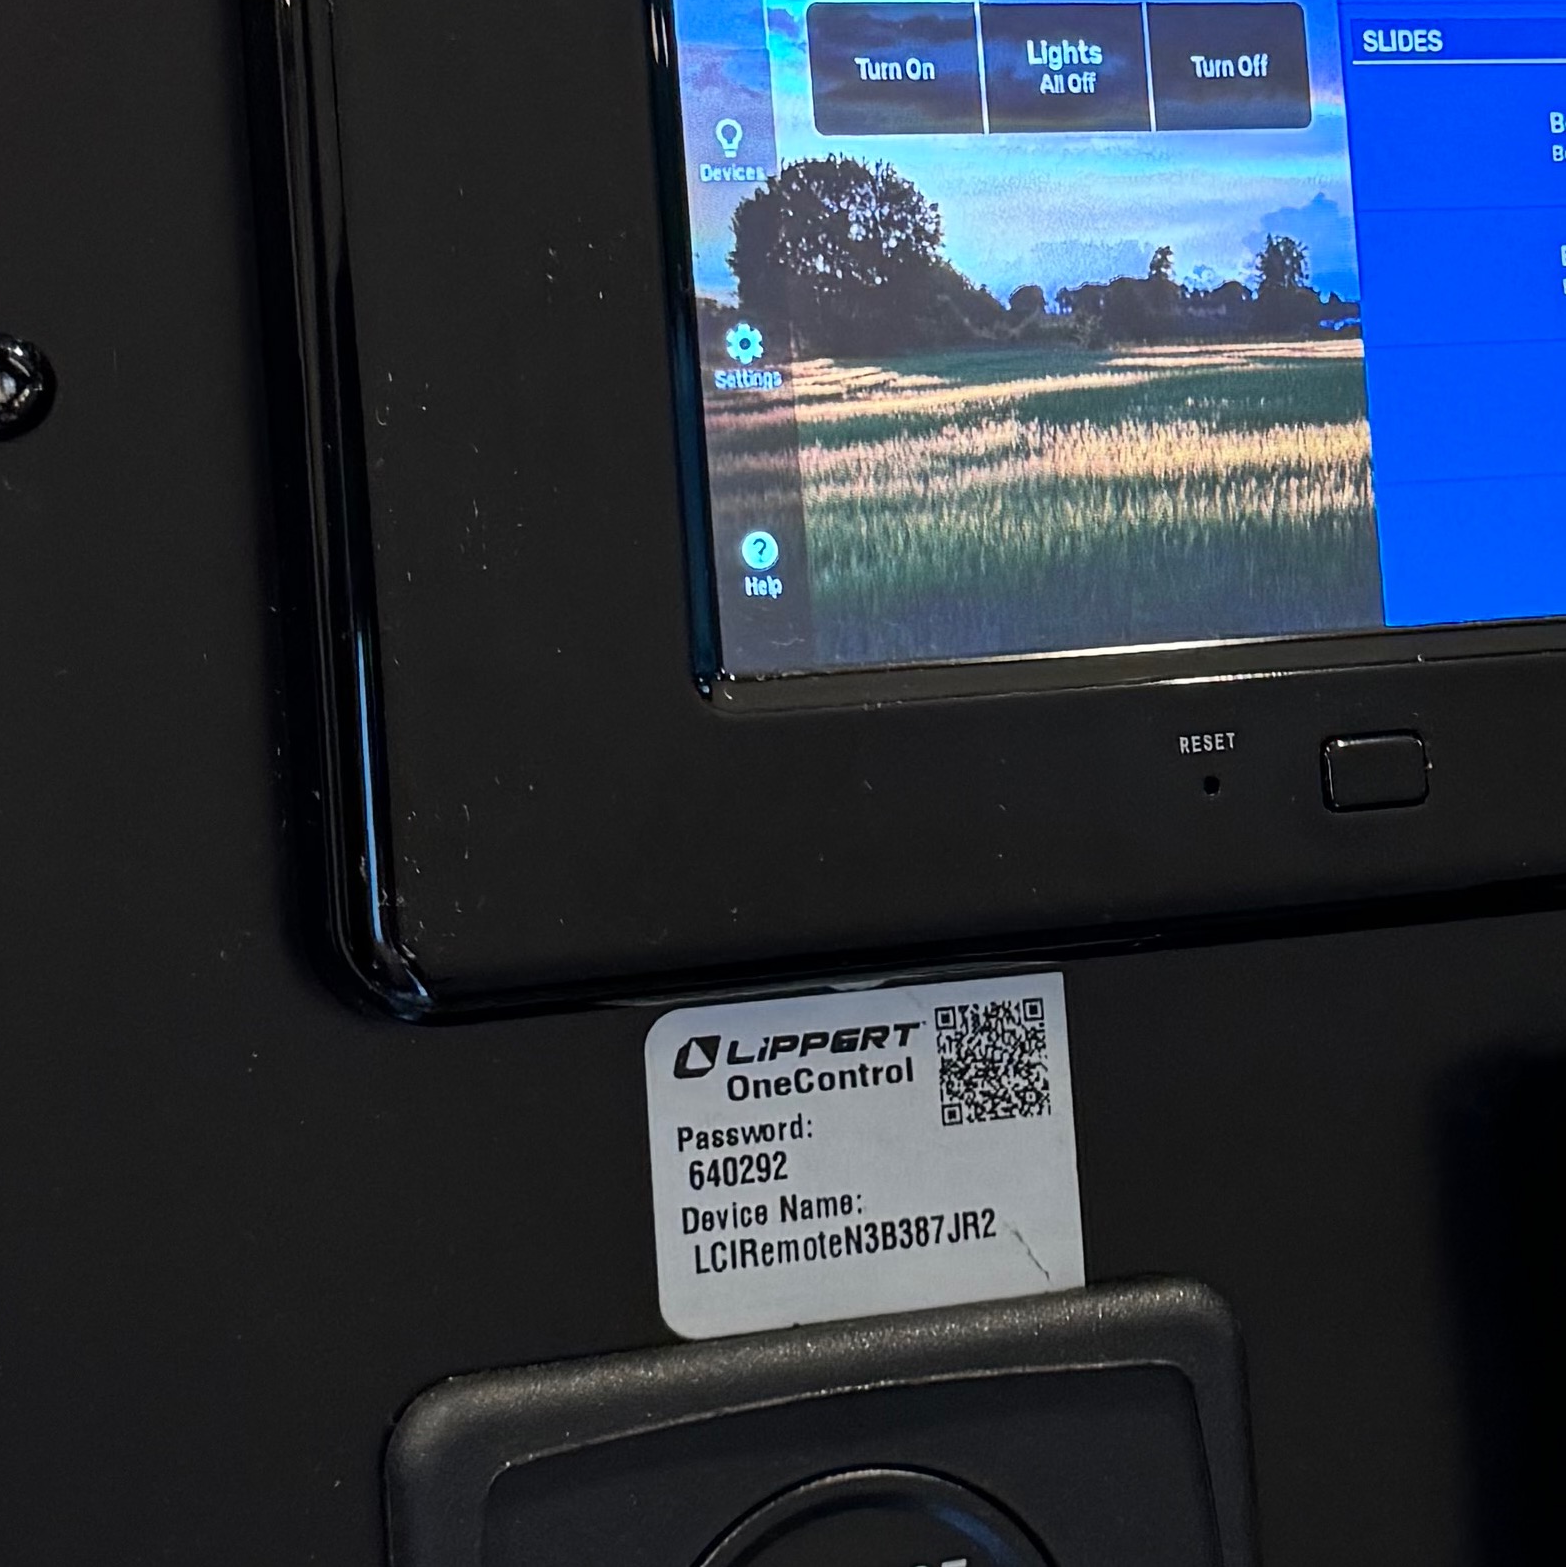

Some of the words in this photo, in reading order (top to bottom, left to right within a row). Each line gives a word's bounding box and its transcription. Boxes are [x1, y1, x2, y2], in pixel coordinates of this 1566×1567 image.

[1363, 29, 1443, 53] SLIDES
[1026, 40, 1104, 69] Lights
[1190, 55, 1235, 78] Turn
[1238, 54, 1269, 78] Off
[854, 58, 903, 81] Turn
[905, 59, 936, 81] On
[1040, 73, 1065, 94] All
[1067, 72, 1097, 93] Off
[699, 163, 767, 183] Devices
[714, 369, 783, 390] Settings
[744, 576, 783, 599] Help
[1178, 732, 1236, 755] RESET
[727, 1057, 914, 1101] OneControl
[677, 1114, 813, 1152] Password:
[689, 1151, 789, 1190] 640292
[681, 1203, 769, 1234] Device
[780, 1192, 863, 1223] Name:
